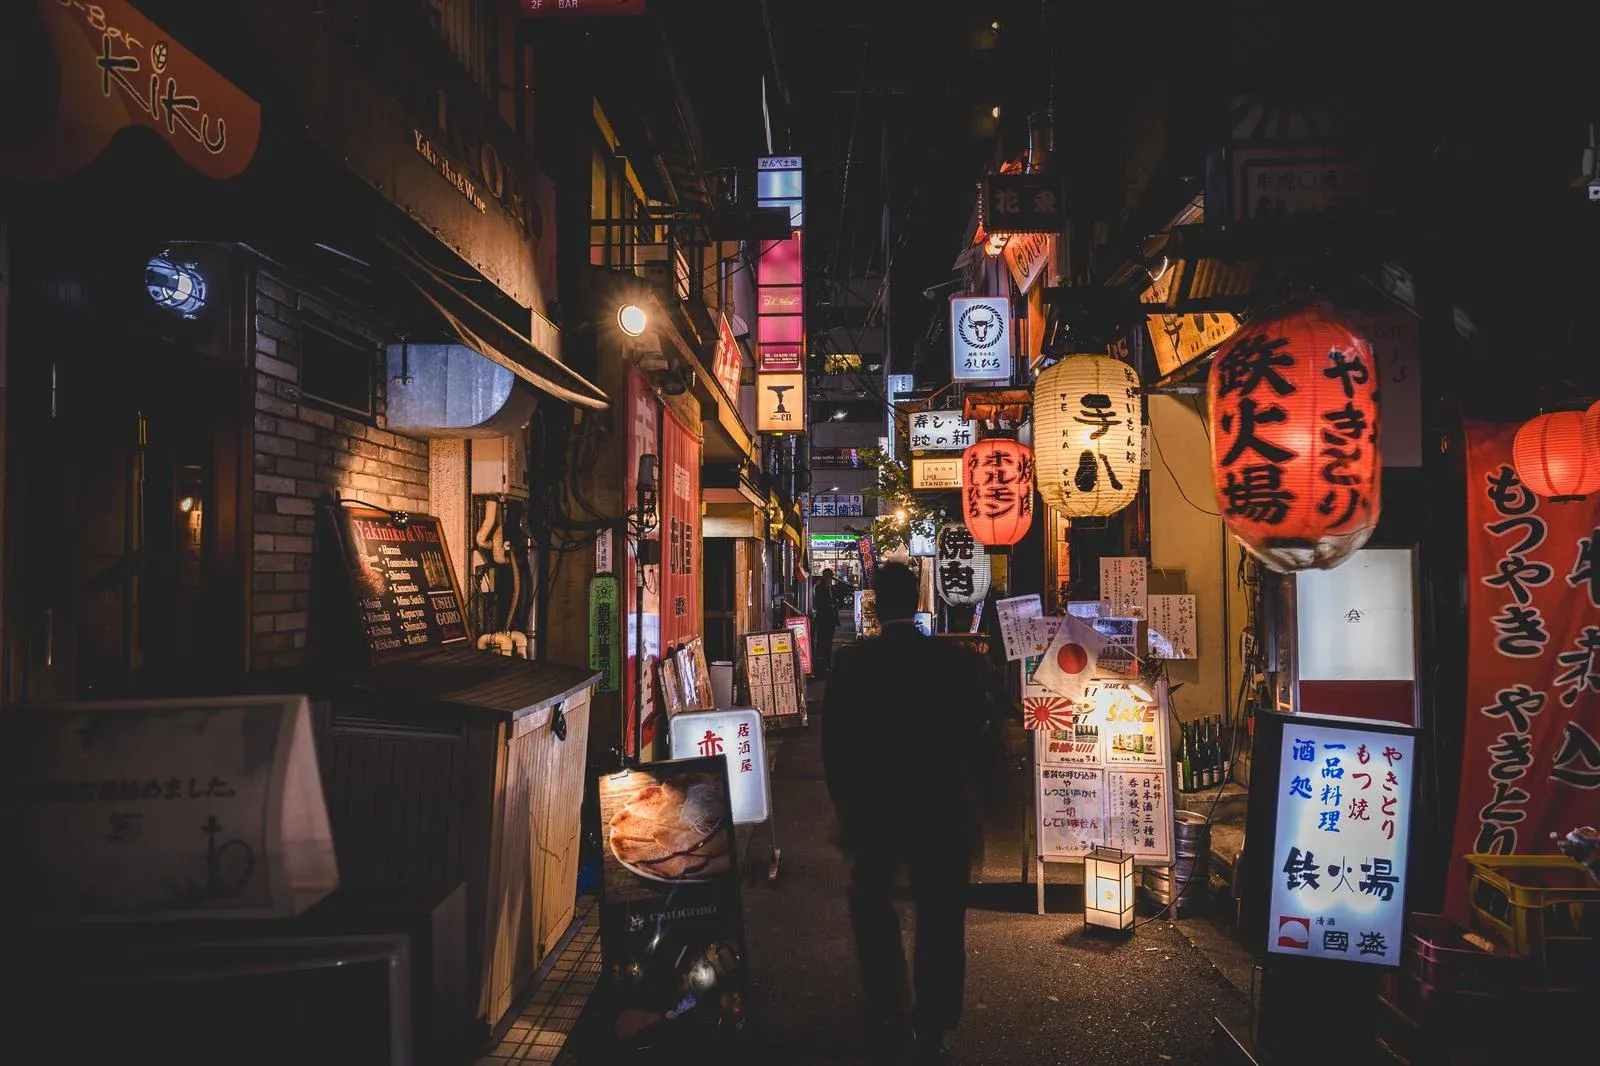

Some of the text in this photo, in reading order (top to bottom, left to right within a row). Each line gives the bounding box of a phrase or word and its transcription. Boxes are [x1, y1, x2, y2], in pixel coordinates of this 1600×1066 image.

[531, 0, 578, 9] 2F BAR
[911, 429, 971, 447] 蛇の新
[1217, 334, 1299, 525] 鉄火場
[1318, 350, 1370, 528] やきとり
[812, 504, 862, 516] 未来歯科
[982, 450, 1018, 519] ホルモン
[939, 526, 975, 597] 焼肉
[1178, 597, 1188, 645] ひやおろし
[1474, 464, 1554, 857] もつやき やきとり
[1105, 703, 1159, 723] SAKE
[737, 723, 753, 774] 居酒屋
[1289, 738, 1316, 800] 酒処
[1042, 769, 1097, 780] 悪質な呼び込み
[1044, 788, 1097, 798] しつこい声かけ
[1317, 743, 1346, 833] 一品料理
[1348, 744, 1373, 821] もつ焼
[1381, 747, 1403, 840] やきとり
[1043, 817, 1098, 829] していません
[1056, 807, 1076, 817] 一切
[1063, 797, 1071, 805] は
[1142, 778, 1155, 848] 日本酒三種類
[1282, 847, 1400, 901] 鉄火場
[1315, 916, 1336, 927] 清酒
